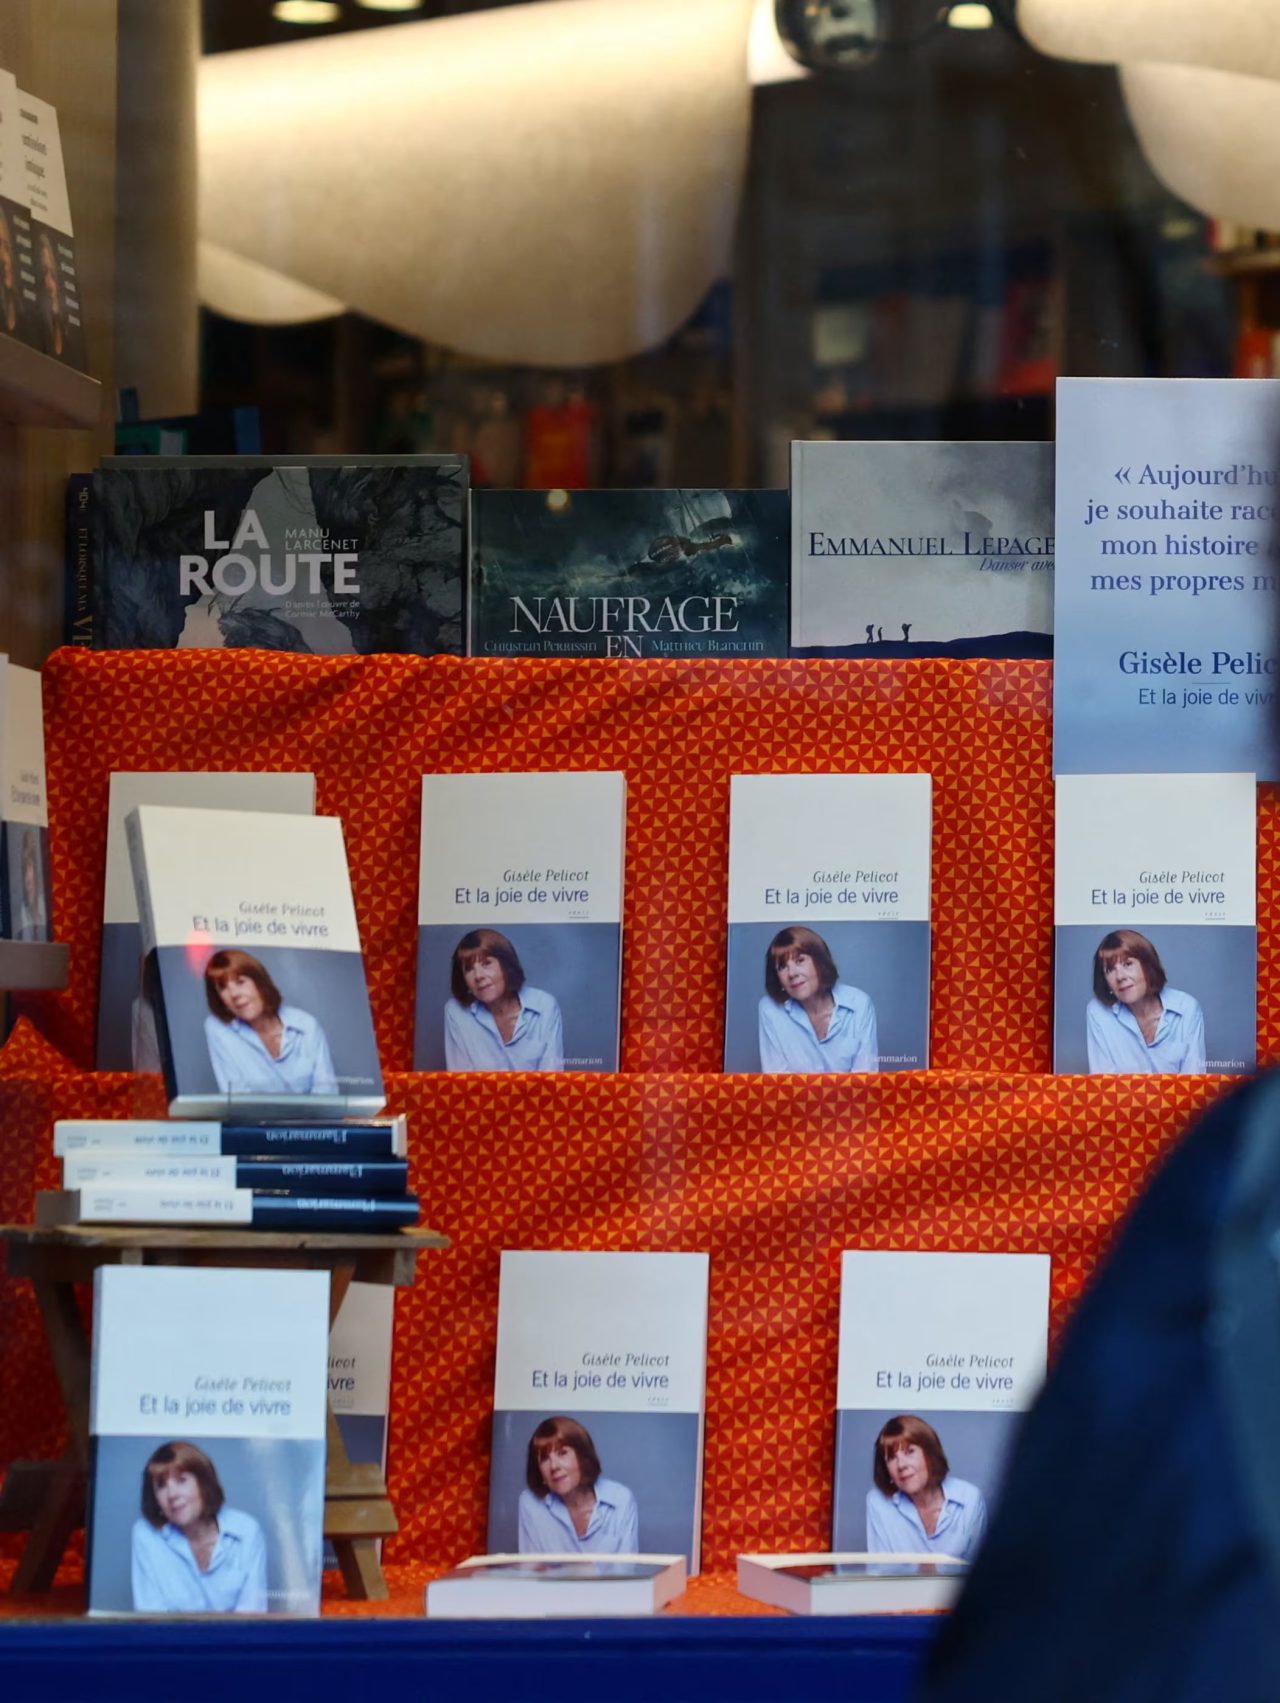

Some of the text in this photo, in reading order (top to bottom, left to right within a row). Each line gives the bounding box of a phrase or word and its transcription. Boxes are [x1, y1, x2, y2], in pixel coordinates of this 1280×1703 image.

[1138, 464, 1279, 490] Aujourd’hu
[1084, 499, 1275, 525] je souhaite rac
[204, 509, 270, 550] LA
[285, 528, 330, 539] MANU
[285, 539, 359, 551] LARCENET
[808, 532, 1056, 555] EMMANUEL LEPAGE
[1101, 534, 1259, 555] mon histoire
[180, 554, 360, 595] ROUTE
[980, 557, 1029, 571] Danser
[1090, 575, 1142, 590] mes
[1149, 575, 1245, 596] propres
[509, 596, 740, 634] NAUFRAGE
[605, 635, 644, 658] EN
[1119, 651, 1279, 675] Gisèle Pelic
[1139, 688, 1156, 704] Et
[1162, 688, 1176, 704] la
[1182, 688, 1212, 708] joie
[1218, 688, 1239, 704] de
[503, 869, 589, 882] Gisèle Pelicot
[813, 870, 898, 883] Gisèle Pelicot
[1139, 870, 1225, 884] Gisèle Pelicot
[455, 886, 589, 906] Et la joie de vivre
[765, 887, 898, 907] Et la joie de vivre
[1092, 888, 1225, 908] Et la joie de vivre
[192, 916, 329, 937] Et la joie de vivre
[582, 1352, 670, 1367] Gisèle Pelicot
[926, 1353, 1014, 1368] Gisèle Pelicot
[532, 1370, 669, 1391] Et la joie de vivre
[876, 1371, 1013, 1392] Et la joie de vivre
[139, 1394, 291, 1418] Et la joie de vivre
